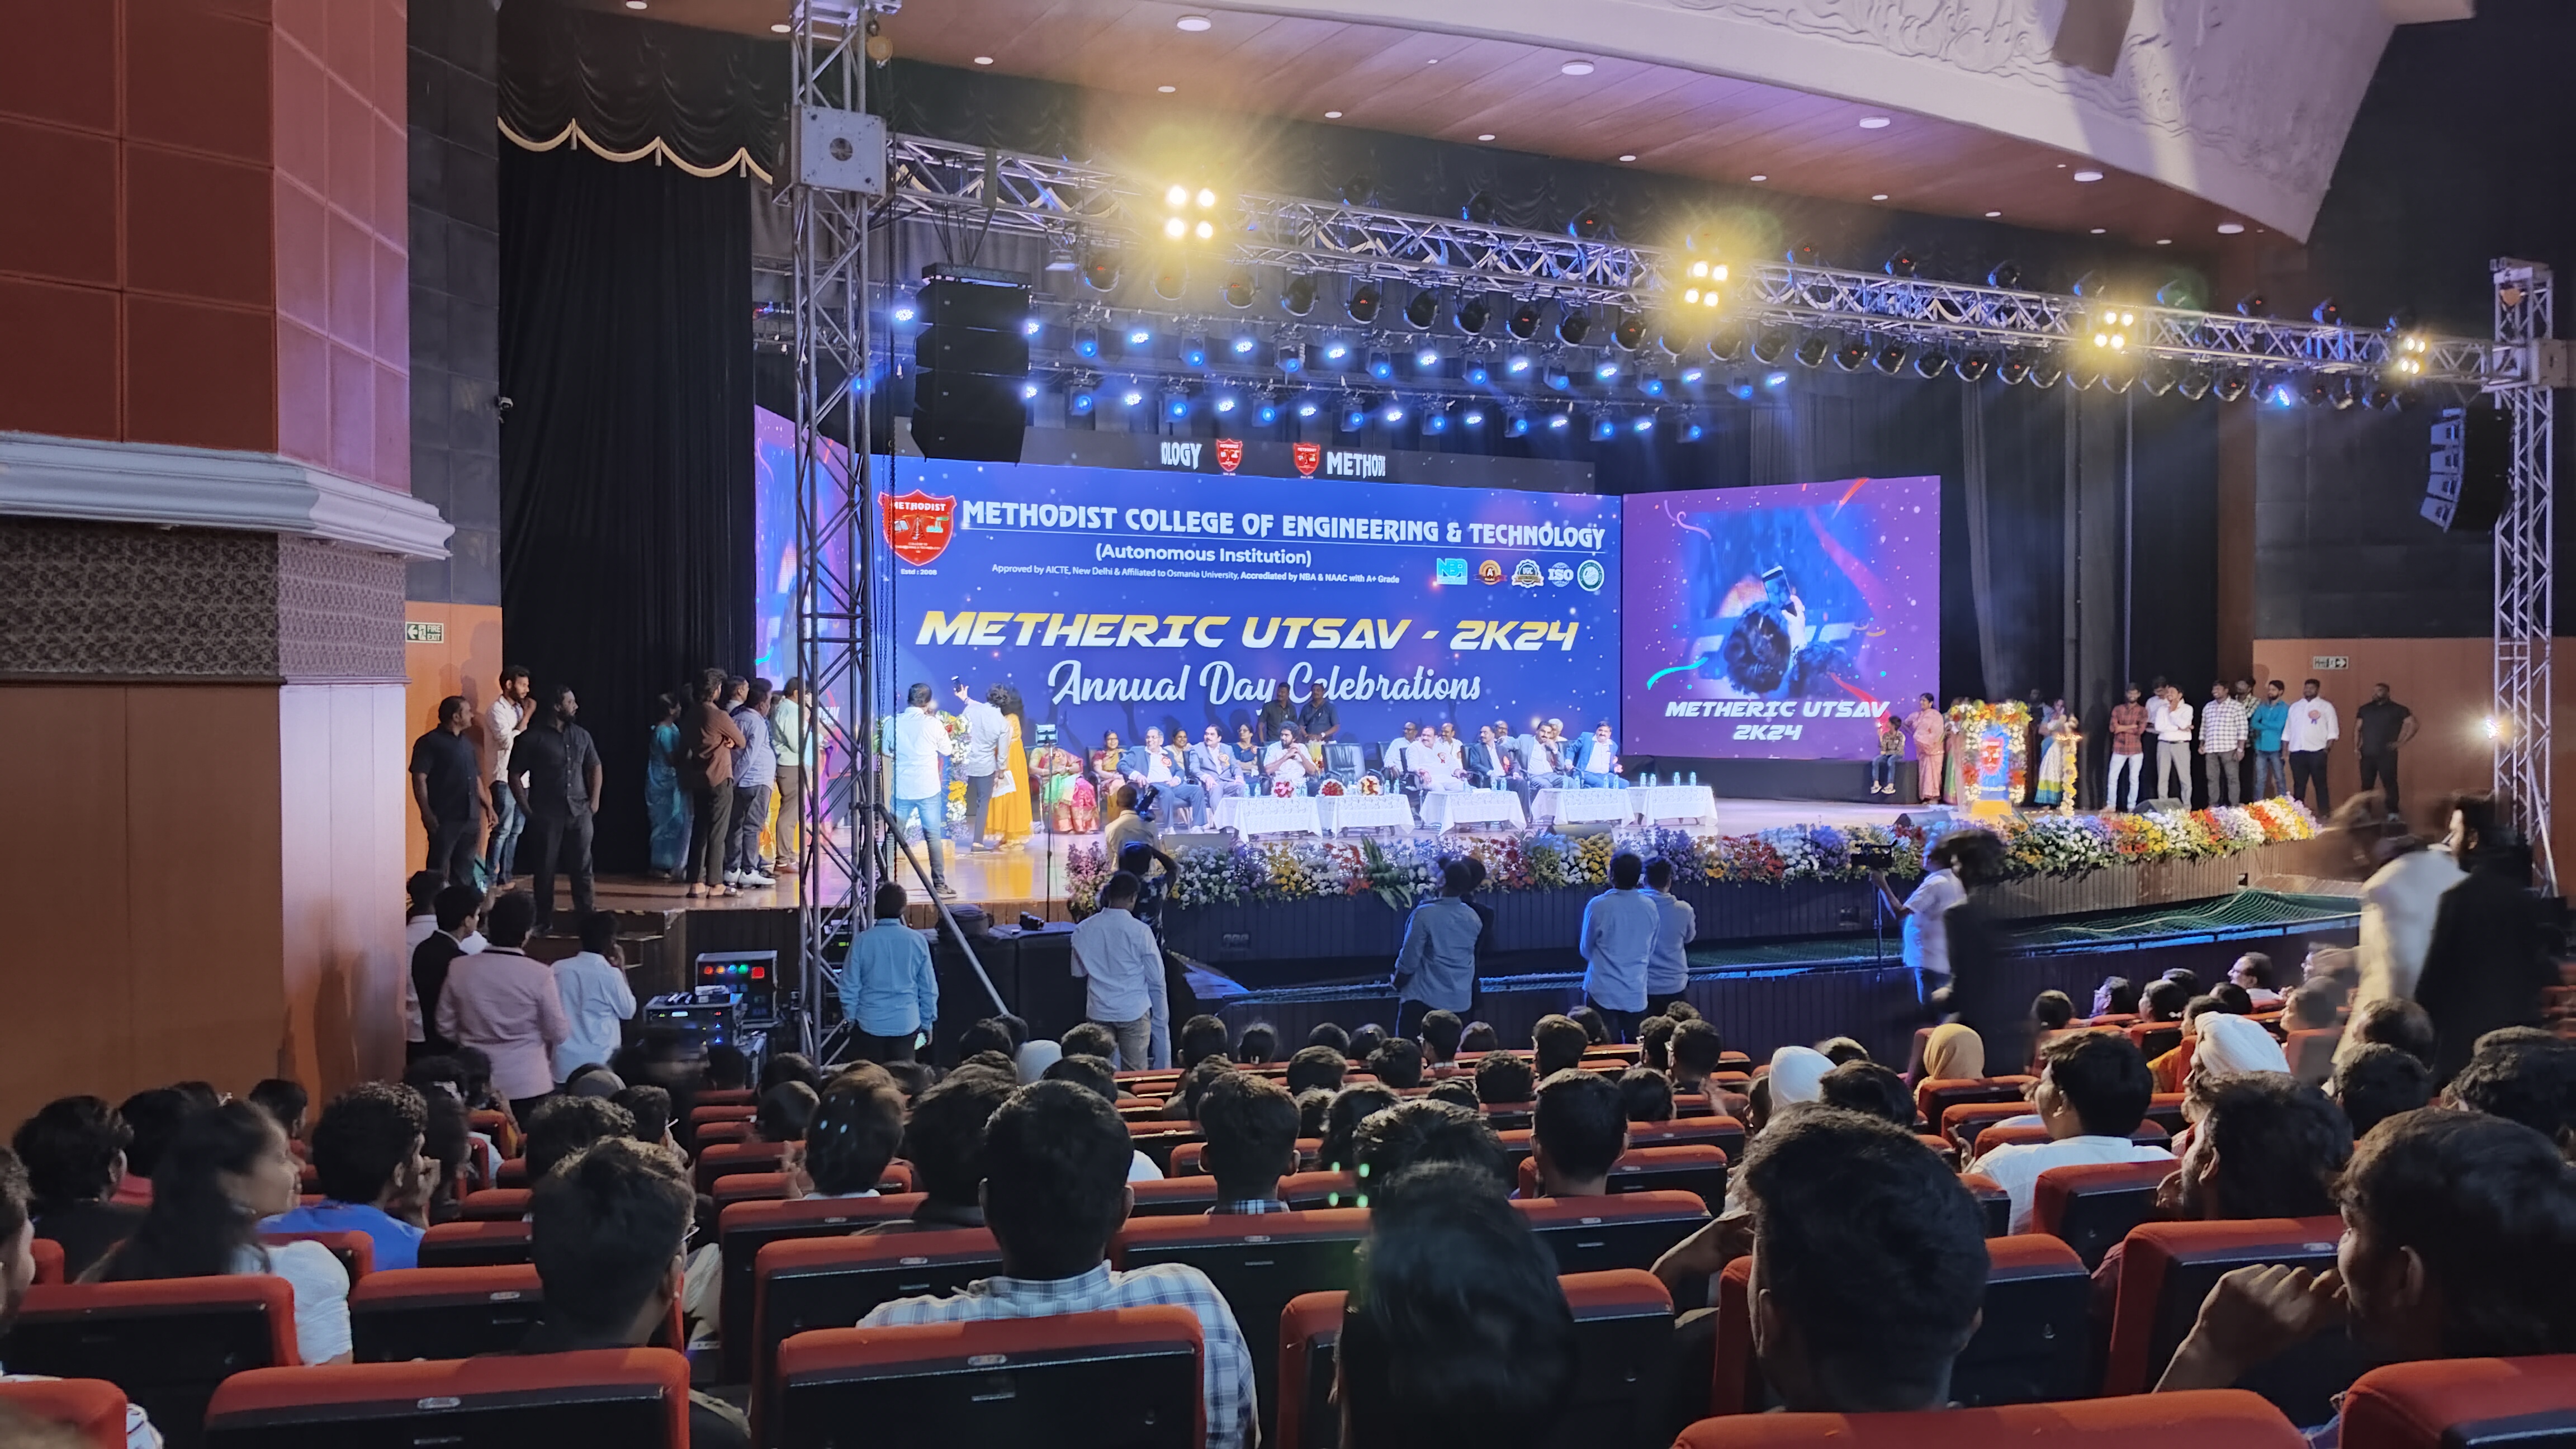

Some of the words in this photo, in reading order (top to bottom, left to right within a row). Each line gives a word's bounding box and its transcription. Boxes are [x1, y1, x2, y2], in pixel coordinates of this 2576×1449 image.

[963, 500, 1117, 528] METHODIST
[1125, 508, 1234, 533] COLLEGE
[1243, 513, 1273, 538] OF
[1283, 515, 1439, 542] ENGINEERING
[1446, 522, 1462, 542] &
[1469, 523, 1606, 550] TECHNOLOGY
[1096, 543, 1216, 561] (Autonomous
[1220, 547, 1311, 568] Institution)
[992, 564, 1032, 575] Approved
[1034, 565, 1044, 575] by
[1045, 566, 1071, 575] AICTE,
[1092, 566, 1113, 576] Delhi
[1121, 567, 1156, 577] Affiliated
[1157, 569, 1166, 577] to
[1167, 569, 1200, 578] Osmania
[1201, 570, 1239, 580] University,
[1288, 572, 1298, 583] by
[1299, 573, 1317, 581] NBA
[1325, 574, 1348, 582] NAAC
[1349, 574, 1365, 583] with
[1377, 575, 1400, 584] Grade
[1548, 569, 1574, 581] ISO
[916, 610, 1230, 648] METHERIC
[1242, 617, 1413, 650] UTSAV
[1421, 630, 1440, 639] -
[1450, 619, 1579, 651] 2K24
[1048, 660, 1190, 705] Annual
[1199, 661, 1276, 716] Day
[1665, 701, 1797, 717] METHERIC
[1803, 700, 1891, 718] UTSAV
[1732, 724, 1803, 741] 2K24
